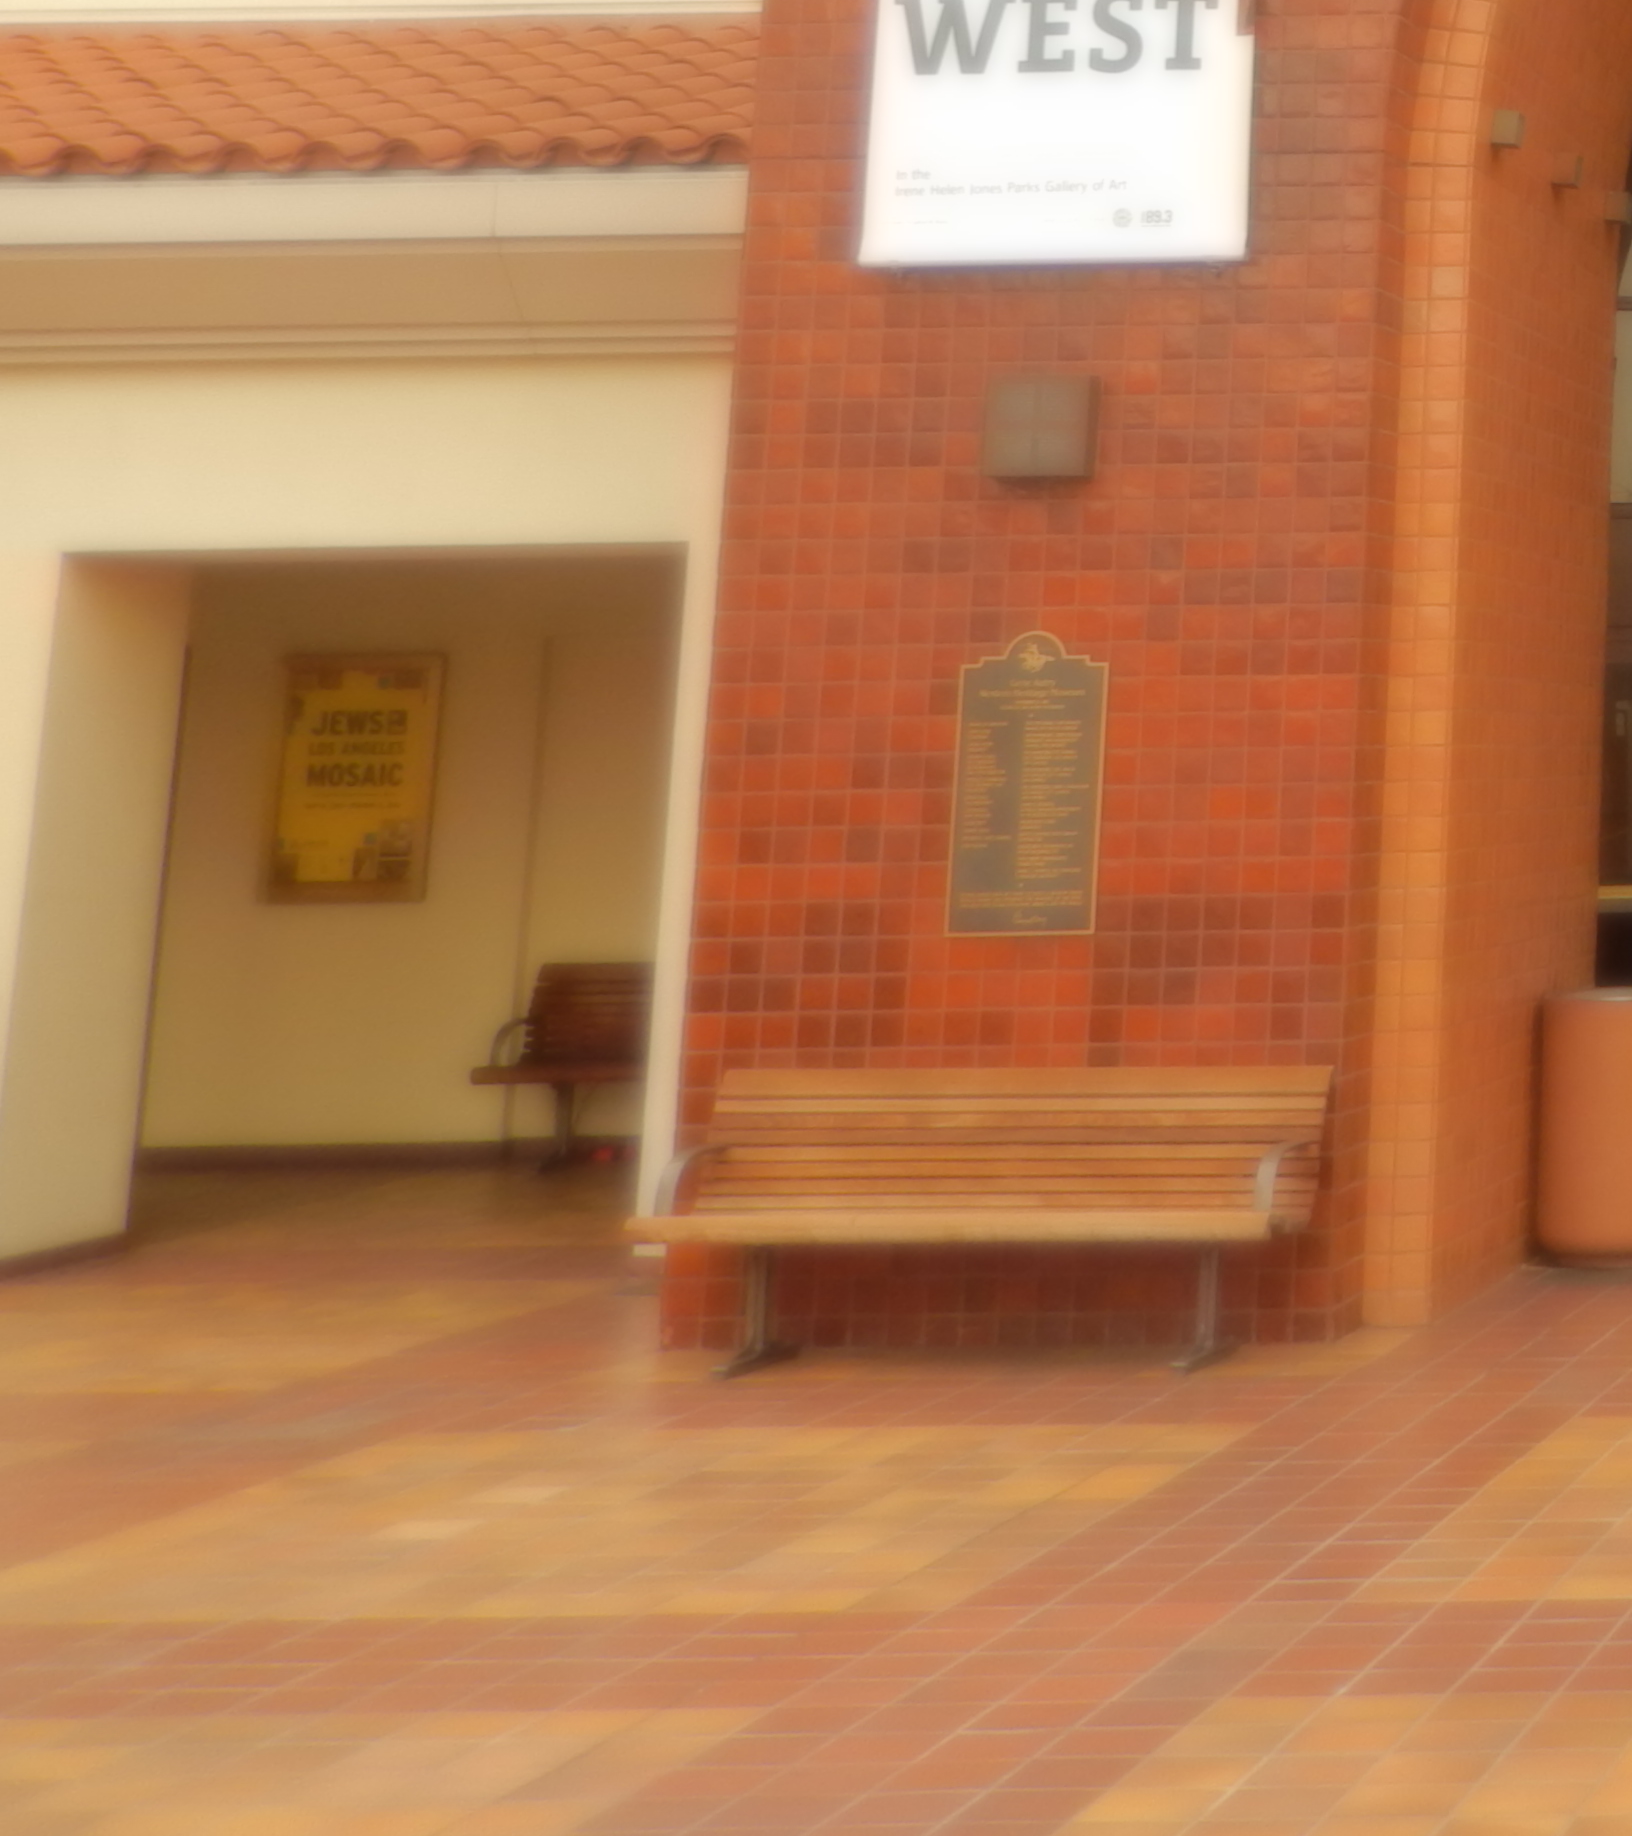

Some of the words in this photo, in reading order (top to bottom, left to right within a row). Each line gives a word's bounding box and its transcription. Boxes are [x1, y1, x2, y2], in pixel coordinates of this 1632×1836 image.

[1092, 178, 1105, 191] of
[1108, 179, 1127, 191] Art
[311, 710, 384, 736] JEWS
[307, 761, 404, 788] MOSAIC
